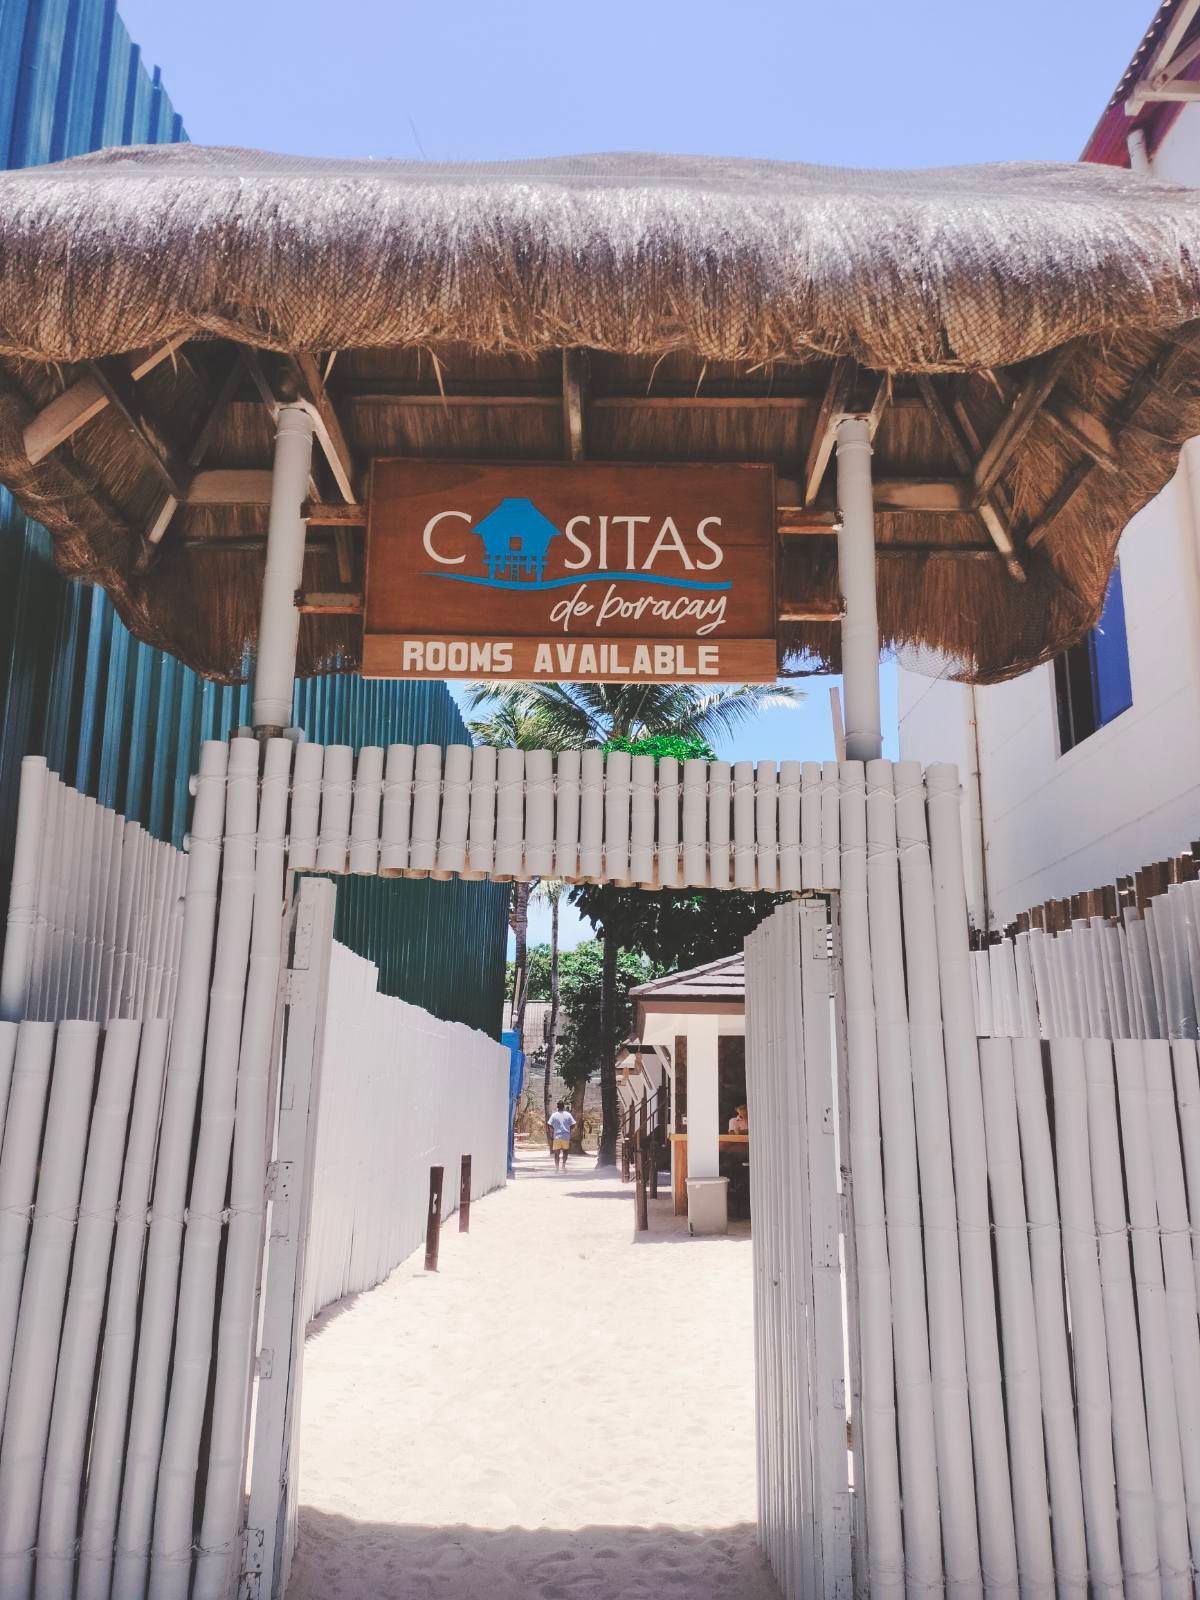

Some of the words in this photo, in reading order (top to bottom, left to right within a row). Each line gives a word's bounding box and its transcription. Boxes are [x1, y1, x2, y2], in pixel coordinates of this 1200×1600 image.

[549, 583, 594, 632] de
[595, 583, 728, 636] boracay
[402, 640, 513, 673] ROOMS
[533, 643, 720, 676] AVAILABLE
